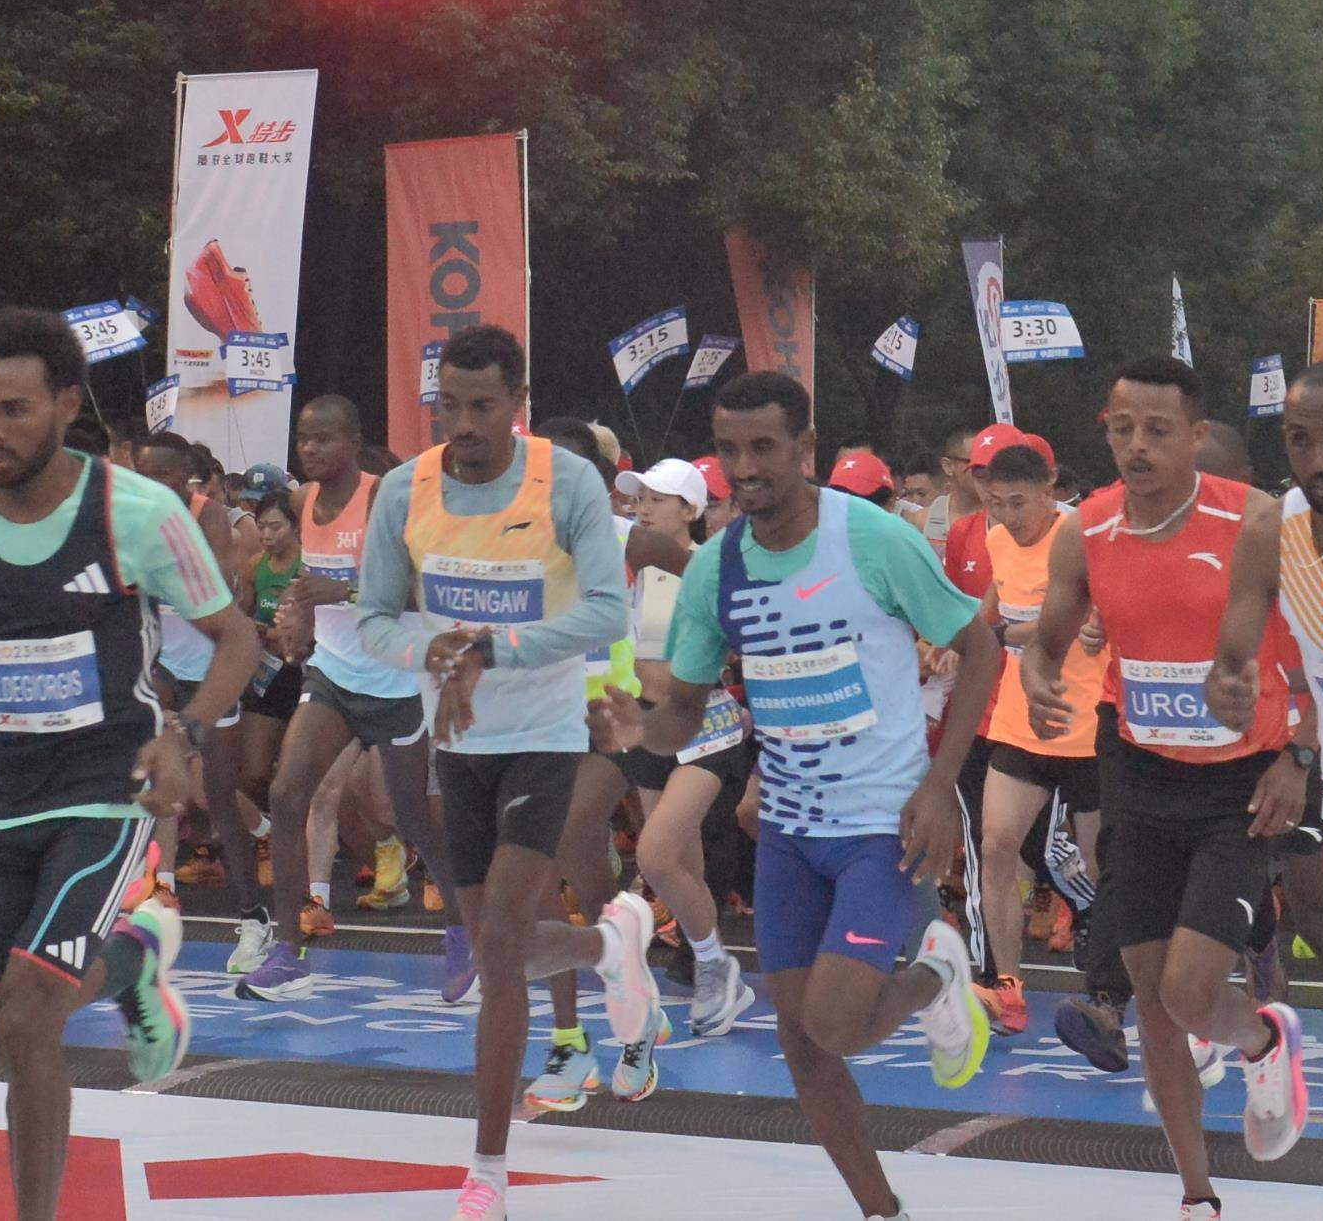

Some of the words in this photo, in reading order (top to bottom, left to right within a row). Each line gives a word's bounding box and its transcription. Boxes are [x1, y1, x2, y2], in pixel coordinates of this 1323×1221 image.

[246, 120, 296, 144] 特步
[81, 319, 117, 341] 3:45
[1012, 318, 1057, 338] 3:30
[627, 327, 669, 362] 3:15
[241, 350, 270, 368] 3:45
[434, 584, 529, 614] YIZENGAW
[768, 660, 801, 676] 2023
[1144, 664, 1178, 678] 2023
